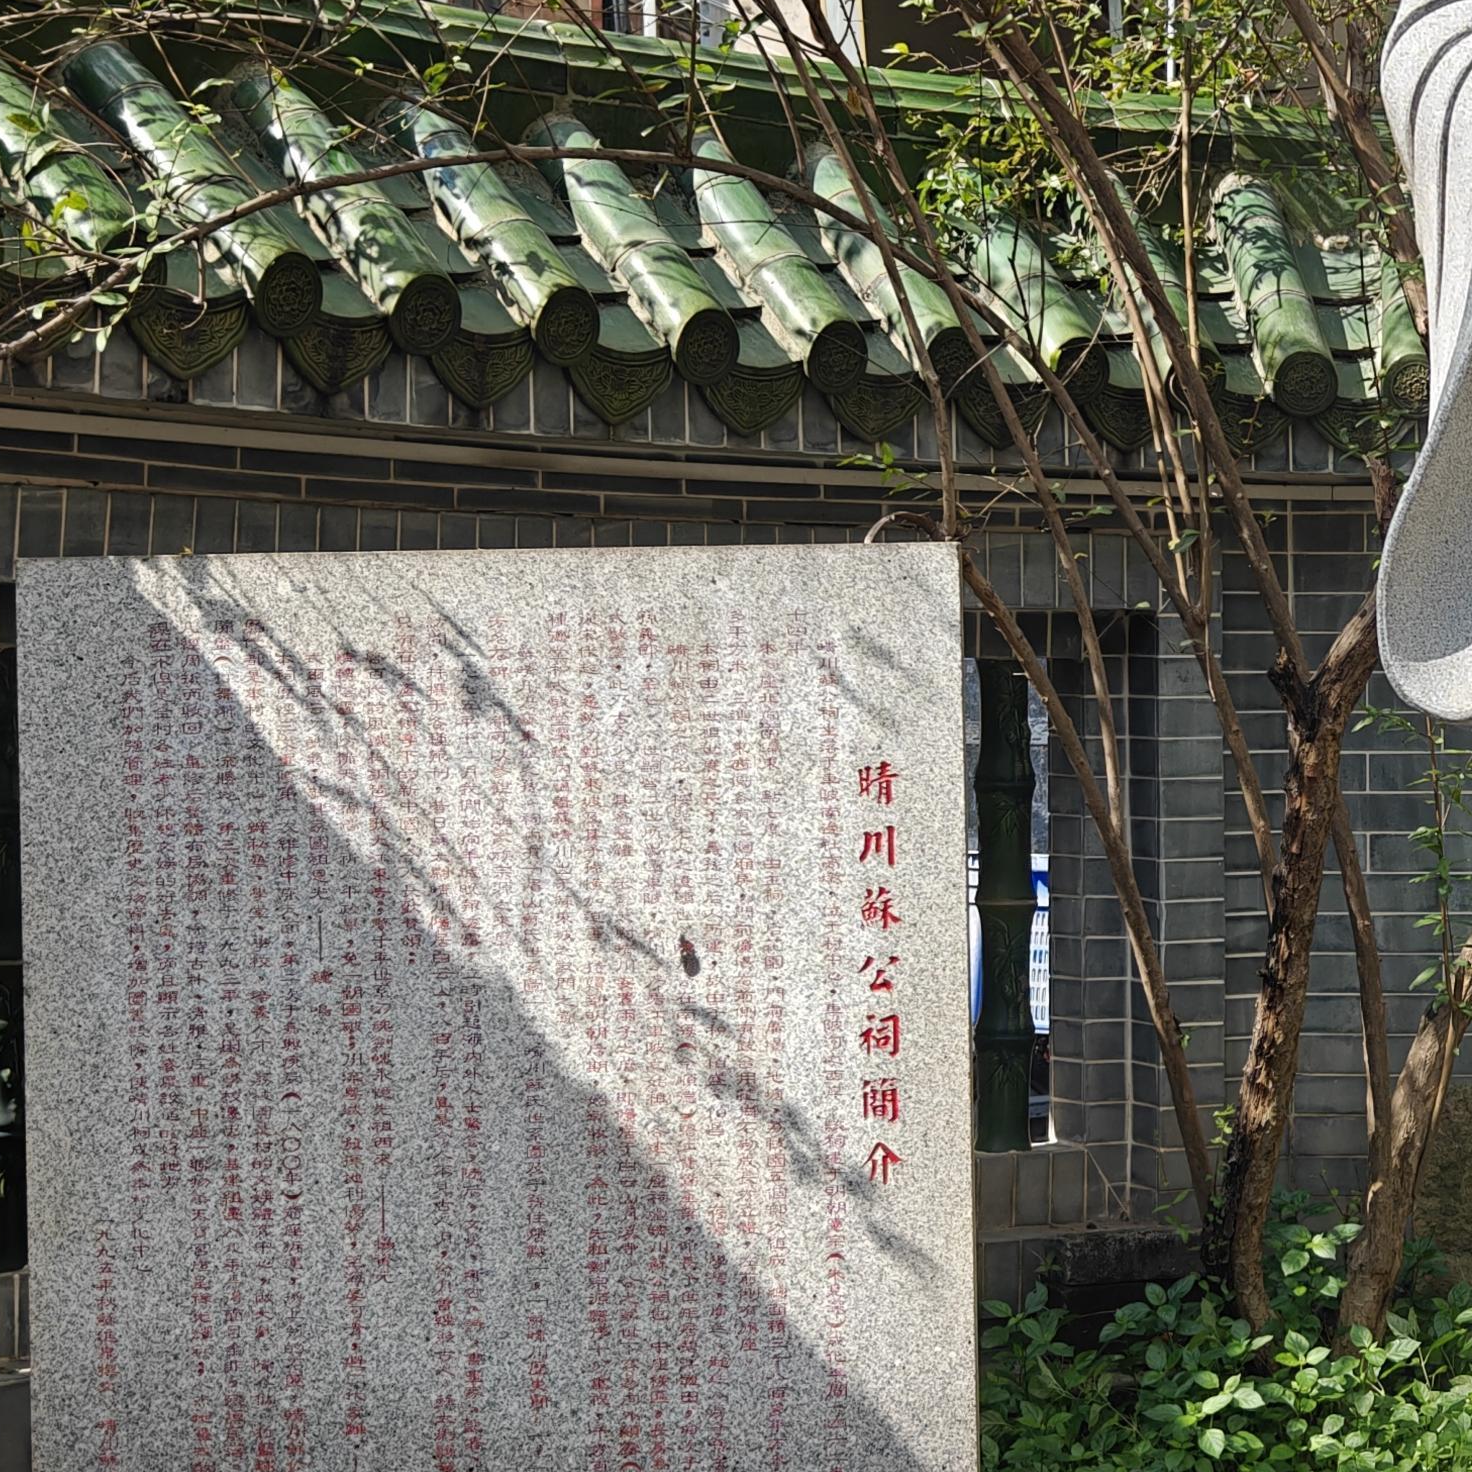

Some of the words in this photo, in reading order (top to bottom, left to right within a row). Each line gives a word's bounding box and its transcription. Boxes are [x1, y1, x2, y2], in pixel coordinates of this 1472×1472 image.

[855, 761, 904, 1185] 晴川蘇公祠簡介
